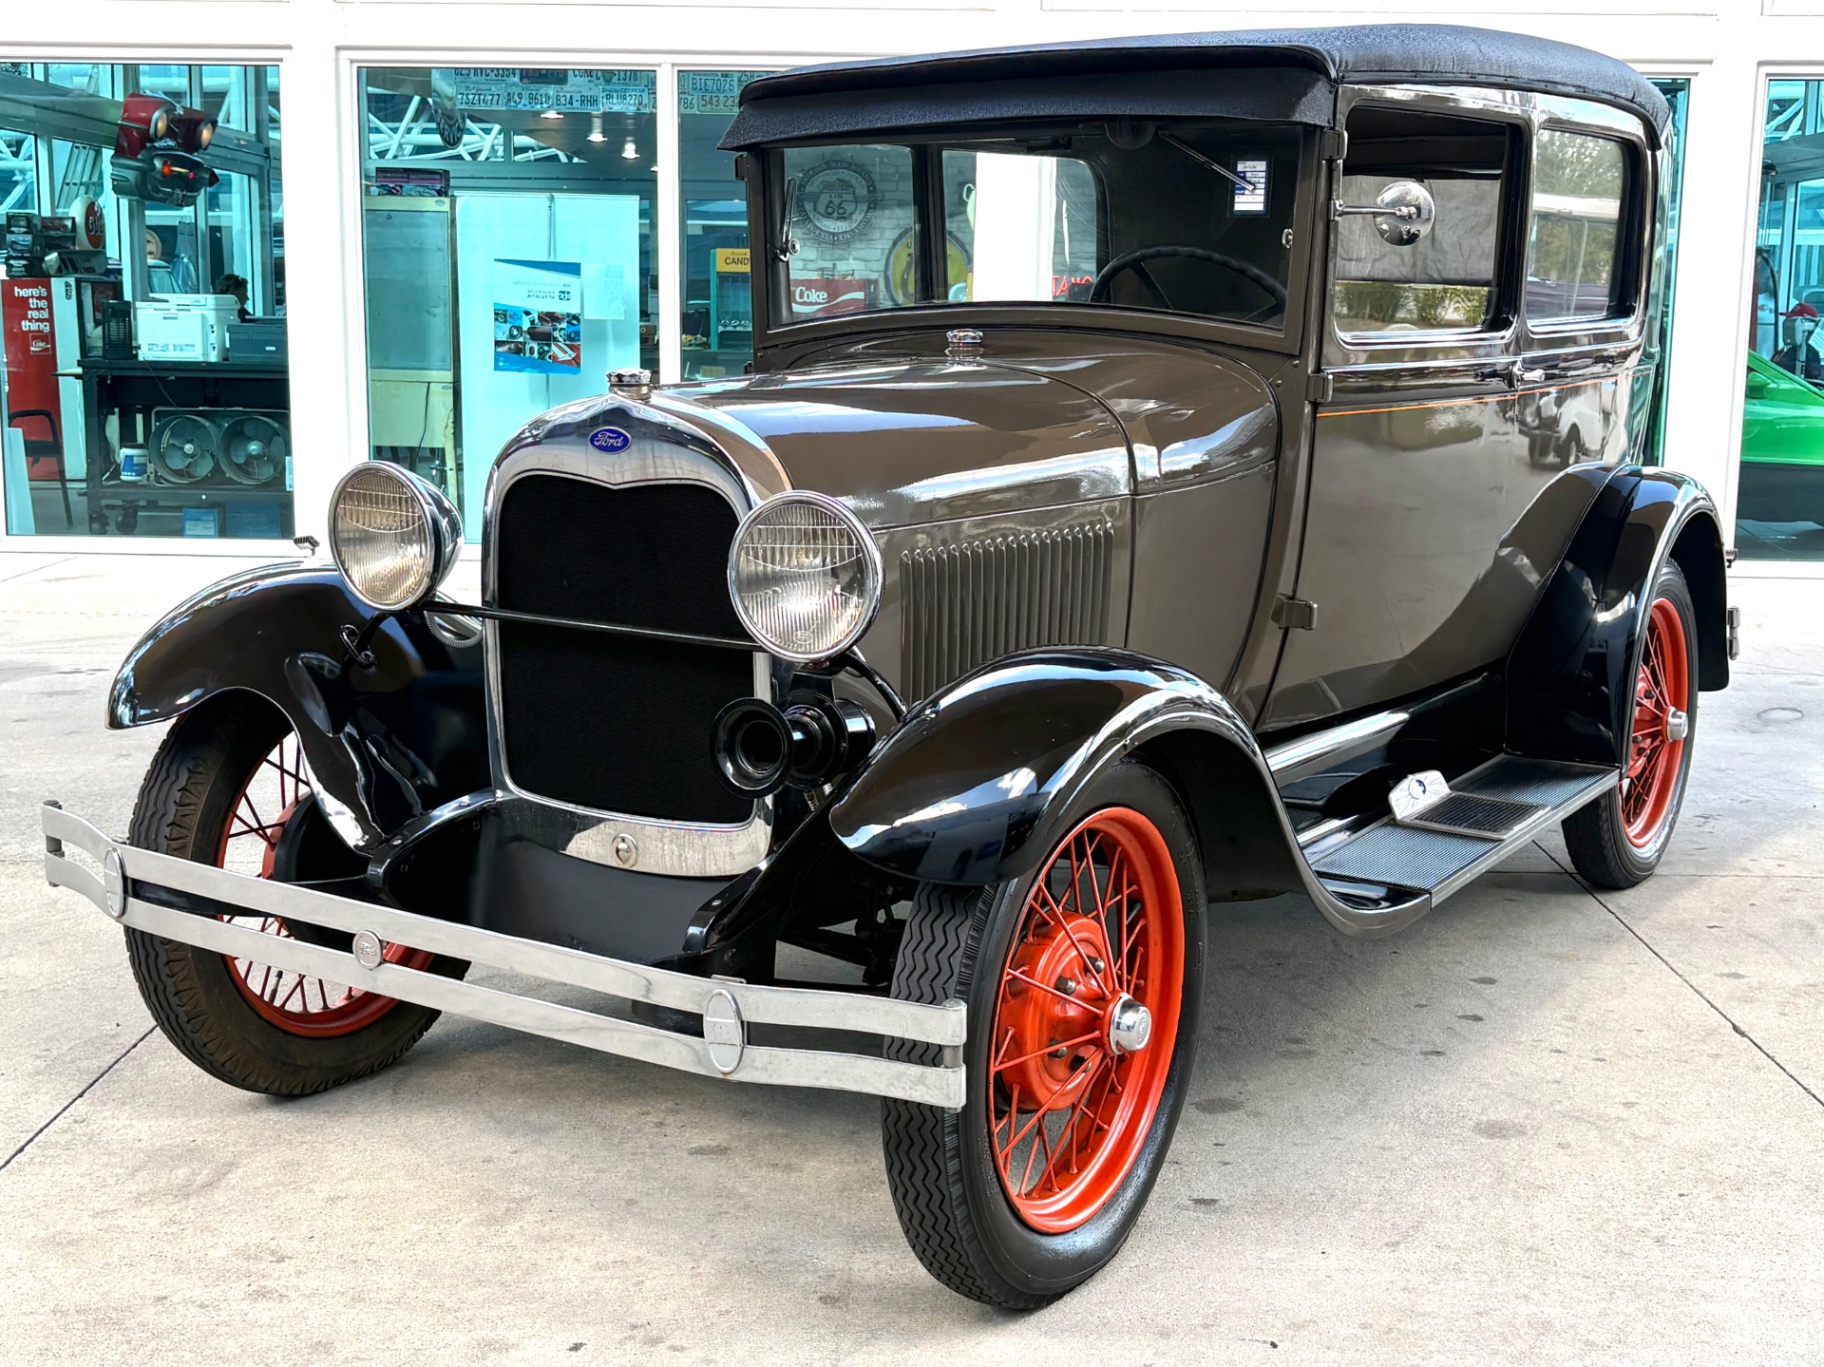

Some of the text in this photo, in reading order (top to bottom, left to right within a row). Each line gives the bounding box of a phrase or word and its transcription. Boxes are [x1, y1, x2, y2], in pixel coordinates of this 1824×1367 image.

[691, 77, 735, 92] BIE7026
[680, 97, 695, 110] 86
[701, 95, 720, 107] 543
[825, 199, 847, 216] 66
[724, 256, 751, 266] CAND
[14, 285, 48, 297] here's
[795, 286, 829, 303] Coke
[28, 297, 48, 309] the
[27, 308, 49, 319] real
[21, 319, 50, 333] thing
[593, 431, 625, 447] Ford
